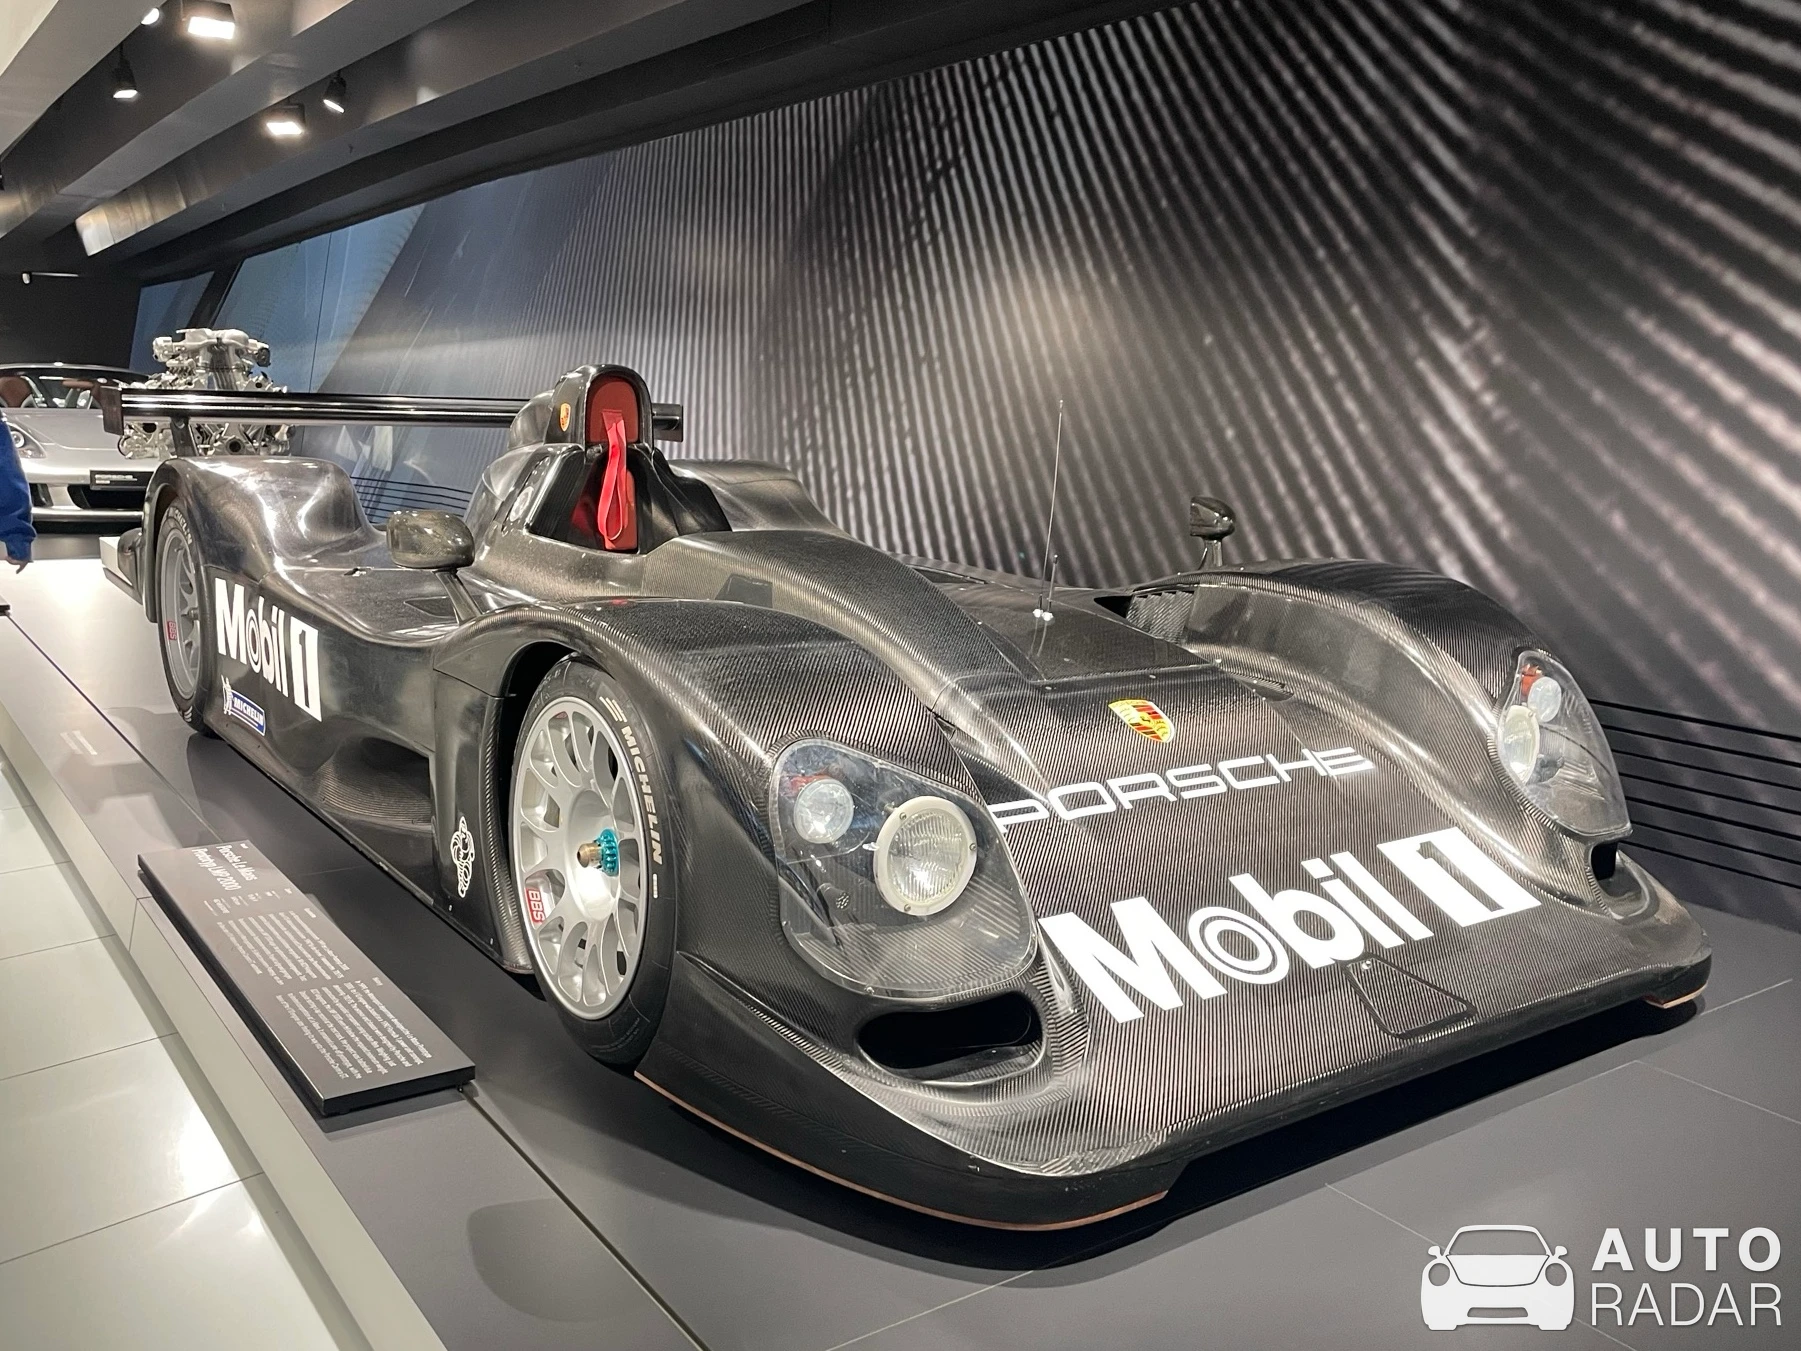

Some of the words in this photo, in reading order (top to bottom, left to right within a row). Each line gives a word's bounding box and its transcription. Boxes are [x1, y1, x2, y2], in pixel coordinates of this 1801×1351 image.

[215, 577, 288, 697] Mobil
[290, 616, 322, 722] 1
[233, 696, 264, 727] MICHELIN
[621, 725, 663, 865] MICHELIN
[988, 746, 1375, 833] PORSCHE
[217, 877, 242, 890] 2000
[528, 890, 545, 921] BBS
[1039, 852, 1434, 1023] Mobil
[1377, 826, 1541, 927] 1
